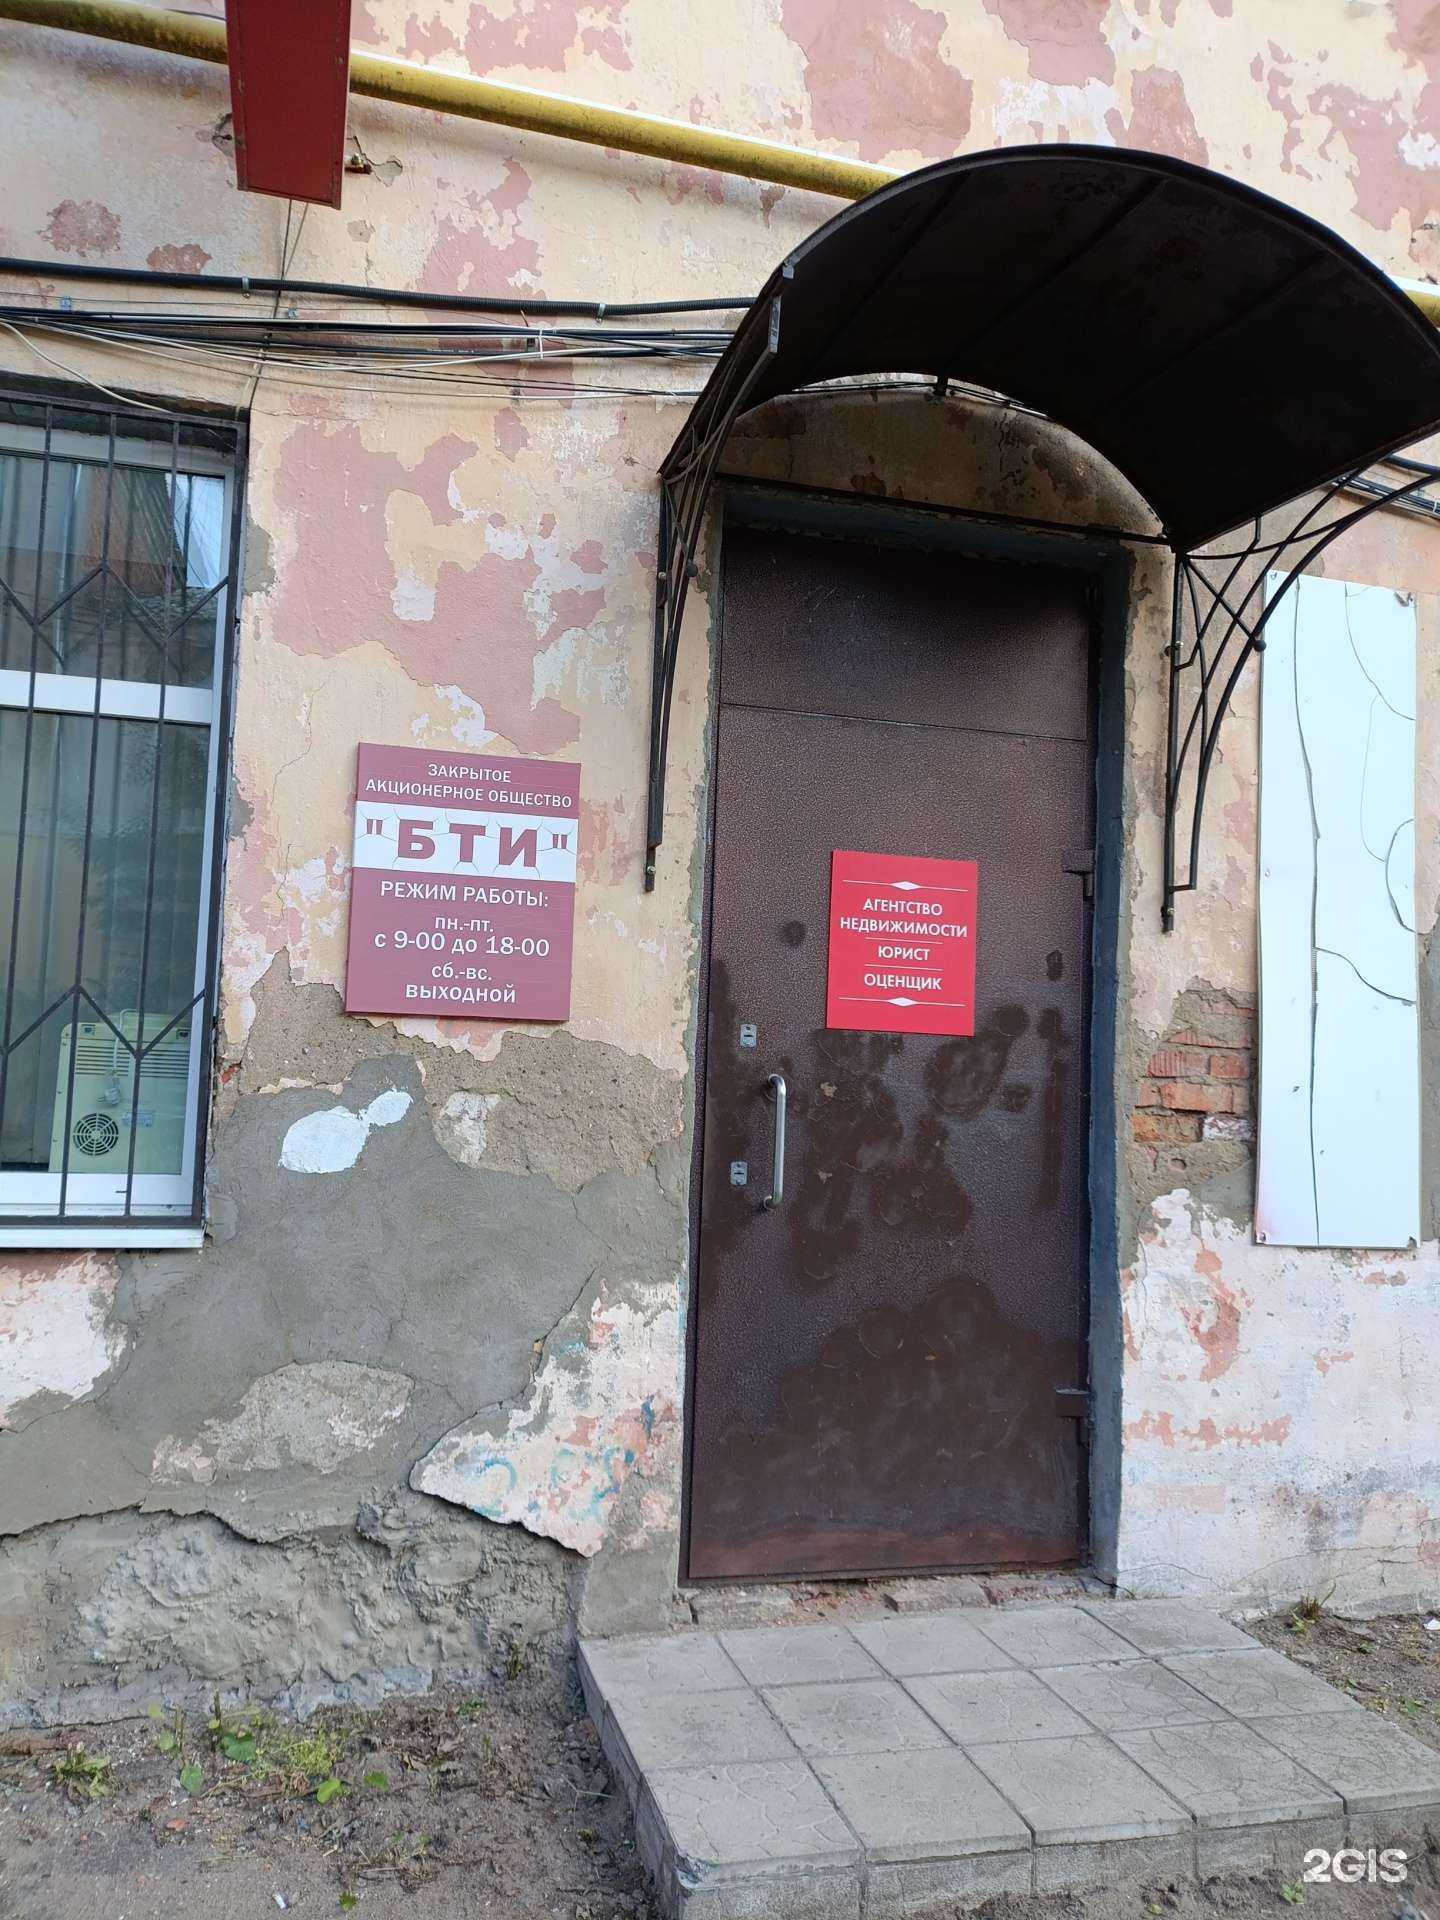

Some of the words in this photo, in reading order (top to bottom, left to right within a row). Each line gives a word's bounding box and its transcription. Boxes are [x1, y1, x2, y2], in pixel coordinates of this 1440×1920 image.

[428, 763, 512, 783] ЗАКРЫТОЕ
[365, 779, 484, 802] АКЦИОНЕРНОЕ
[488, 790, 572, 808] ОБЩЕСТВО
[380, 880, 456, 901] РЕЖИМ
[463, 886, 549, 907] РАБОТЫ:
[863, 898, 943, 916] АГЕНТСТВО
[840, 917, 968, 937] НЕДВИЖИМОСТИ
[394, 930, 446, 951] 9-00
[451, 938, 478, 955] до
[485, 935, 550, 957] 18-00
[878, 946, 931, 961] ЮРИСТ
[431, 961, 493, 981] сб.-вс.
[864, 973, 942, 991] ОЦЕНЩИК
